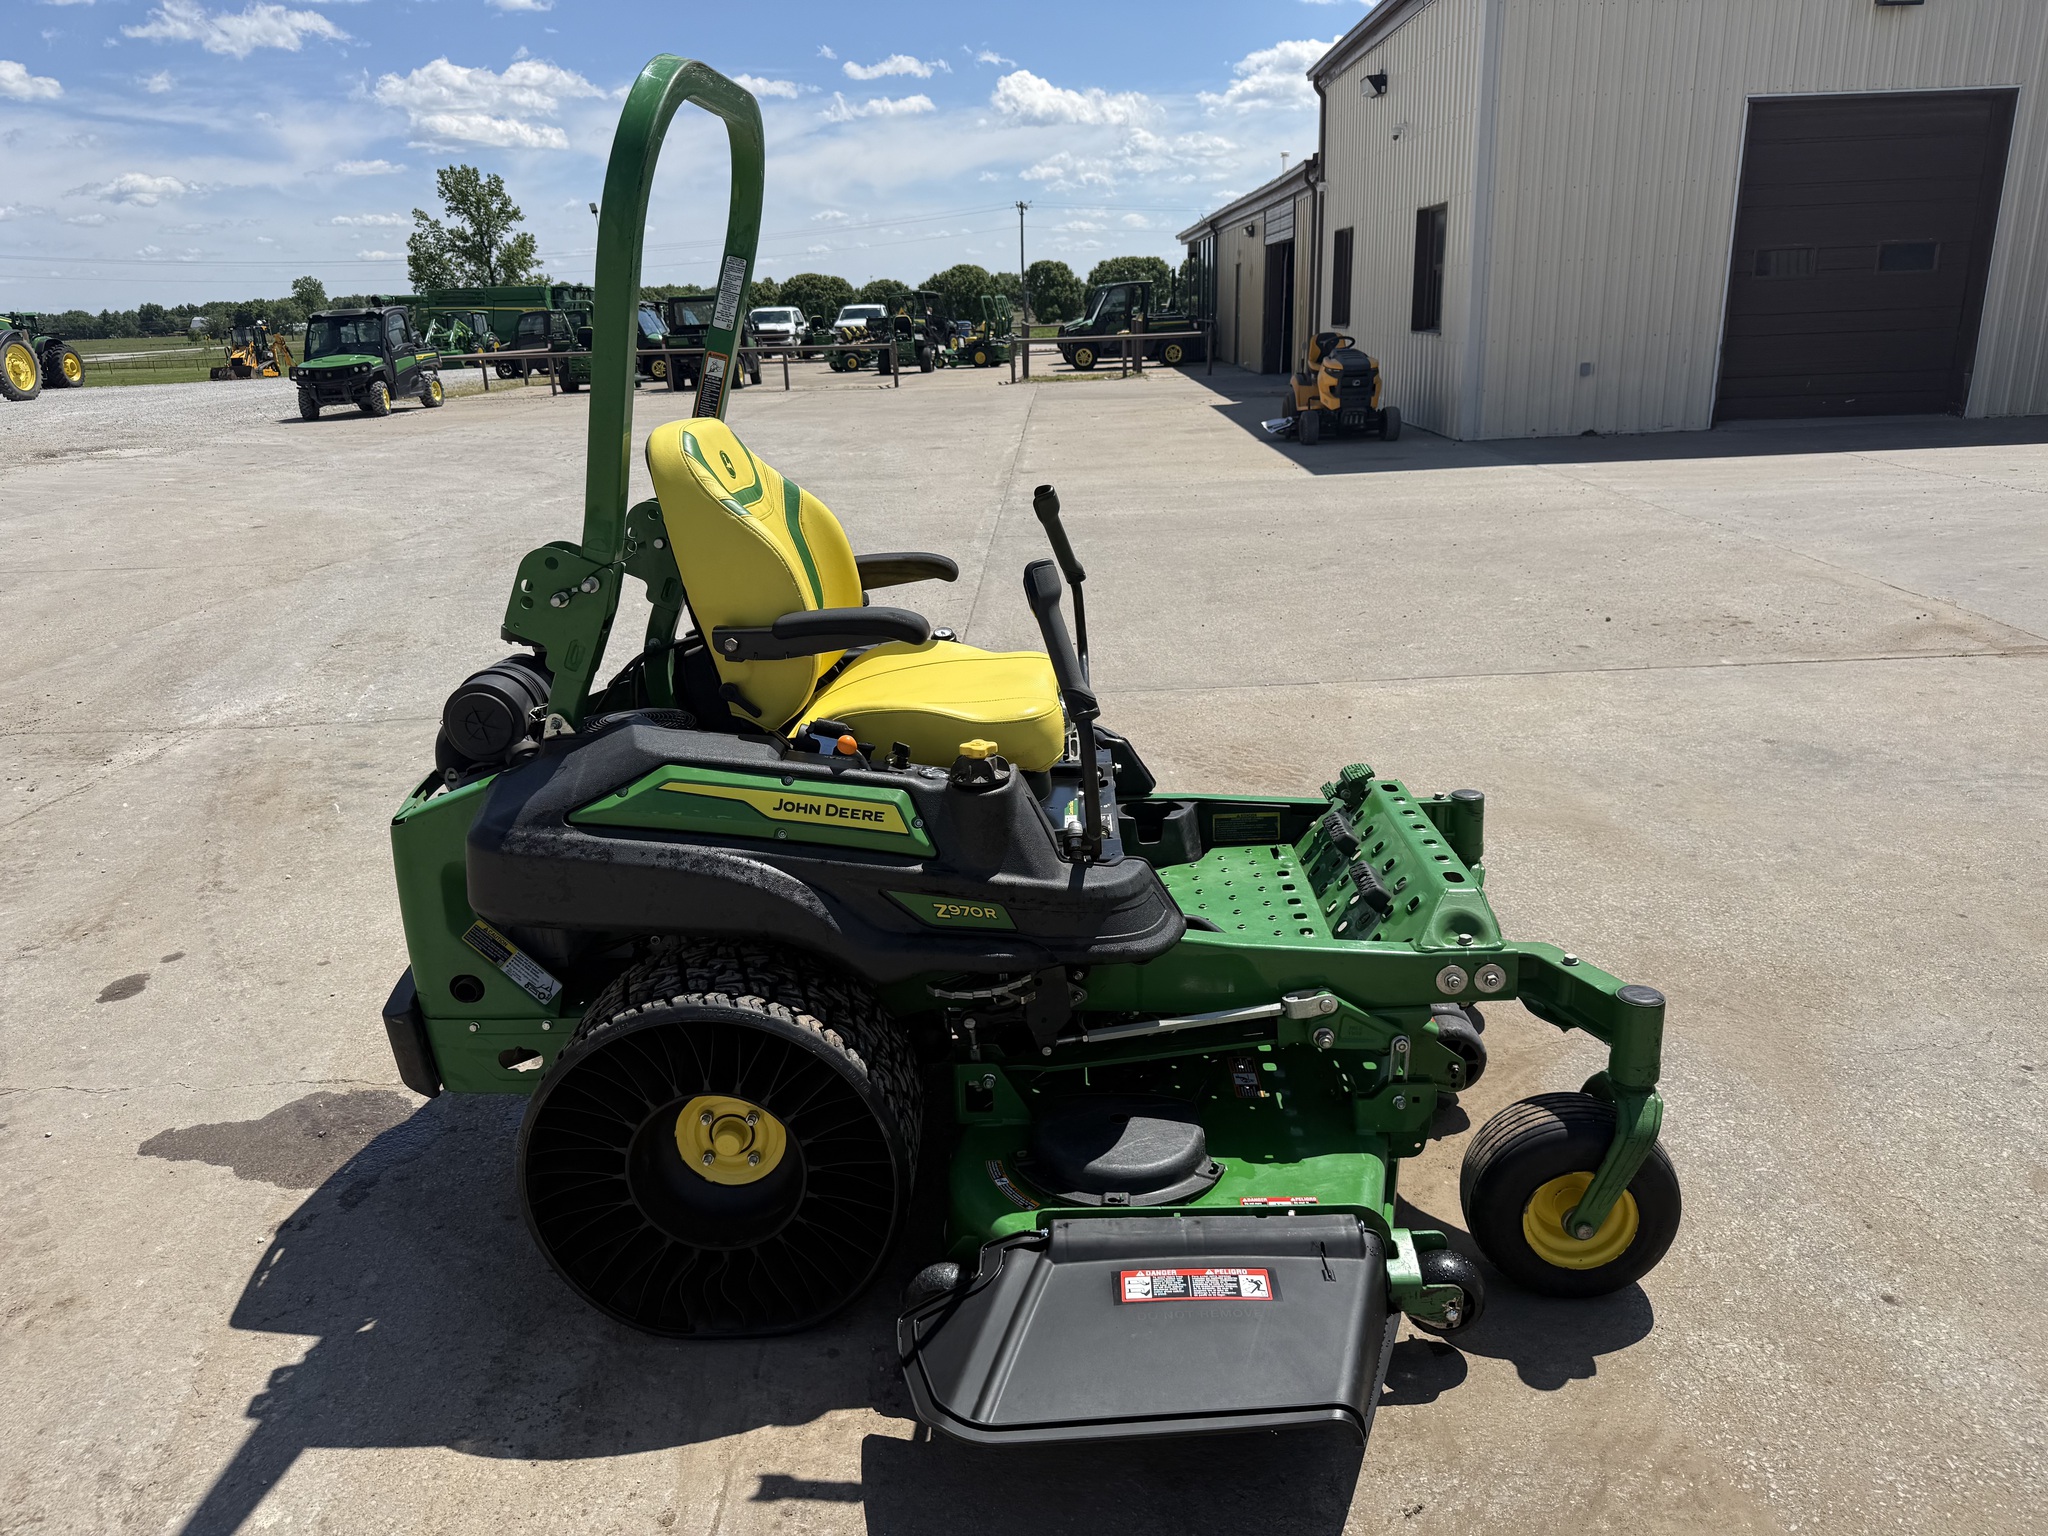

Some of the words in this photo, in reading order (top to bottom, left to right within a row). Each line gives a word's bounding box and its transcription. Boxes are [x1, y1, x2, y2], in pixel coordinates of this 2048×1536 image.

[773, 799, 821, 815] JOHN
[825, 804, 885, 822] DEERE
[933, 904, 997, 919] Z970R
[487, 929, 508, 947] CAUTION
[698, 1008, 769, 1025] MICHELIN
[1138, 1312, 1157, 1321] DO
[1164, 1310, 1194, 1320] NOT
[1200, 1308, 1264, 1319] REMOVE
